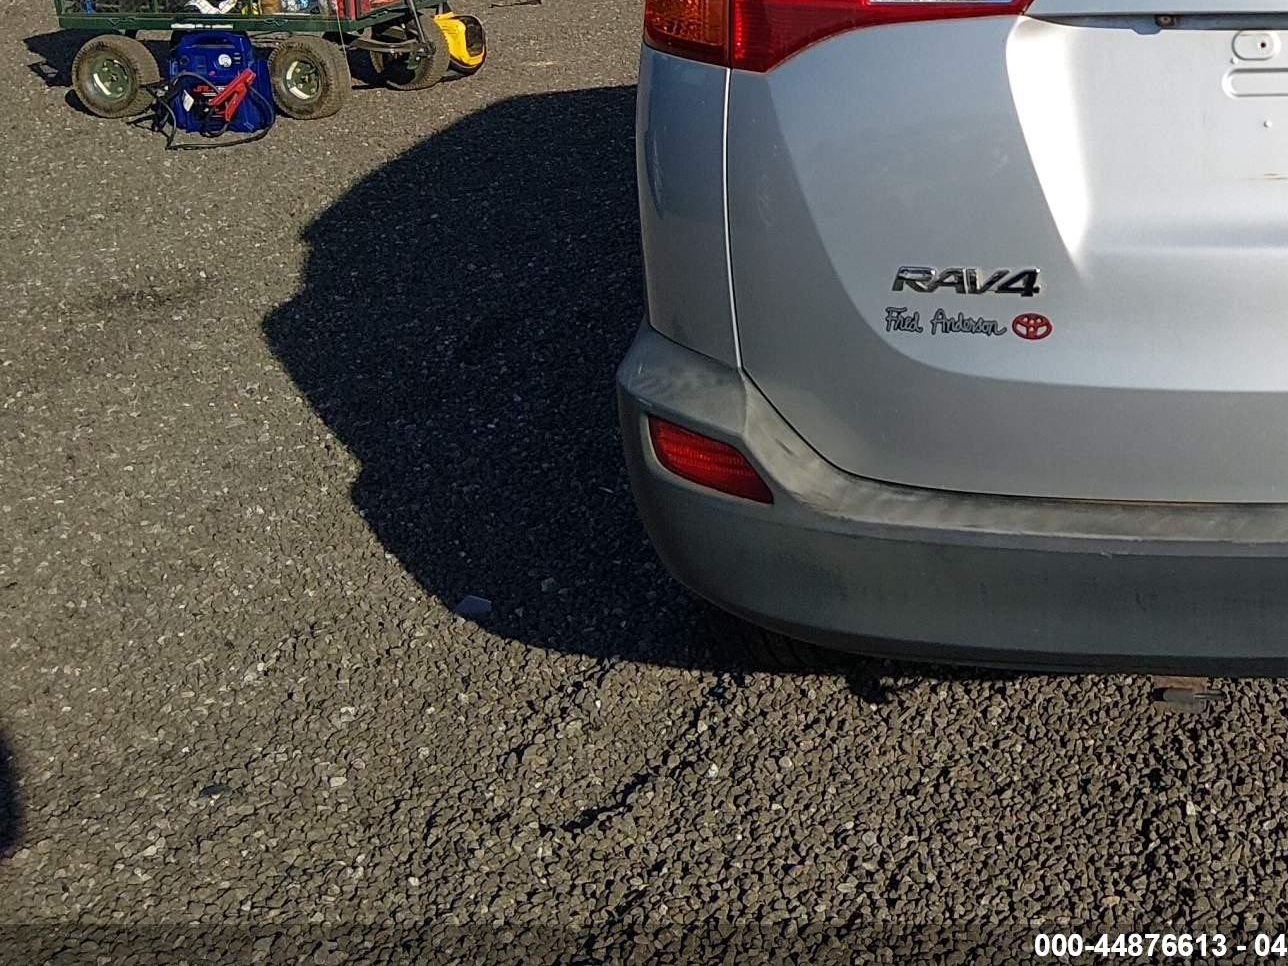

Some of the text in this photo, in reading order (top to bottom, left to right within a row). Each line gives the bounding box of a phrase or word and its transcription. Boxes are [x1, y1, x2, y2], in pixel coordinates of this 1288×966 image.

[891, 266, 1041, 297] RAV4
[885, 306, 1007, 336] Fred Anderson
